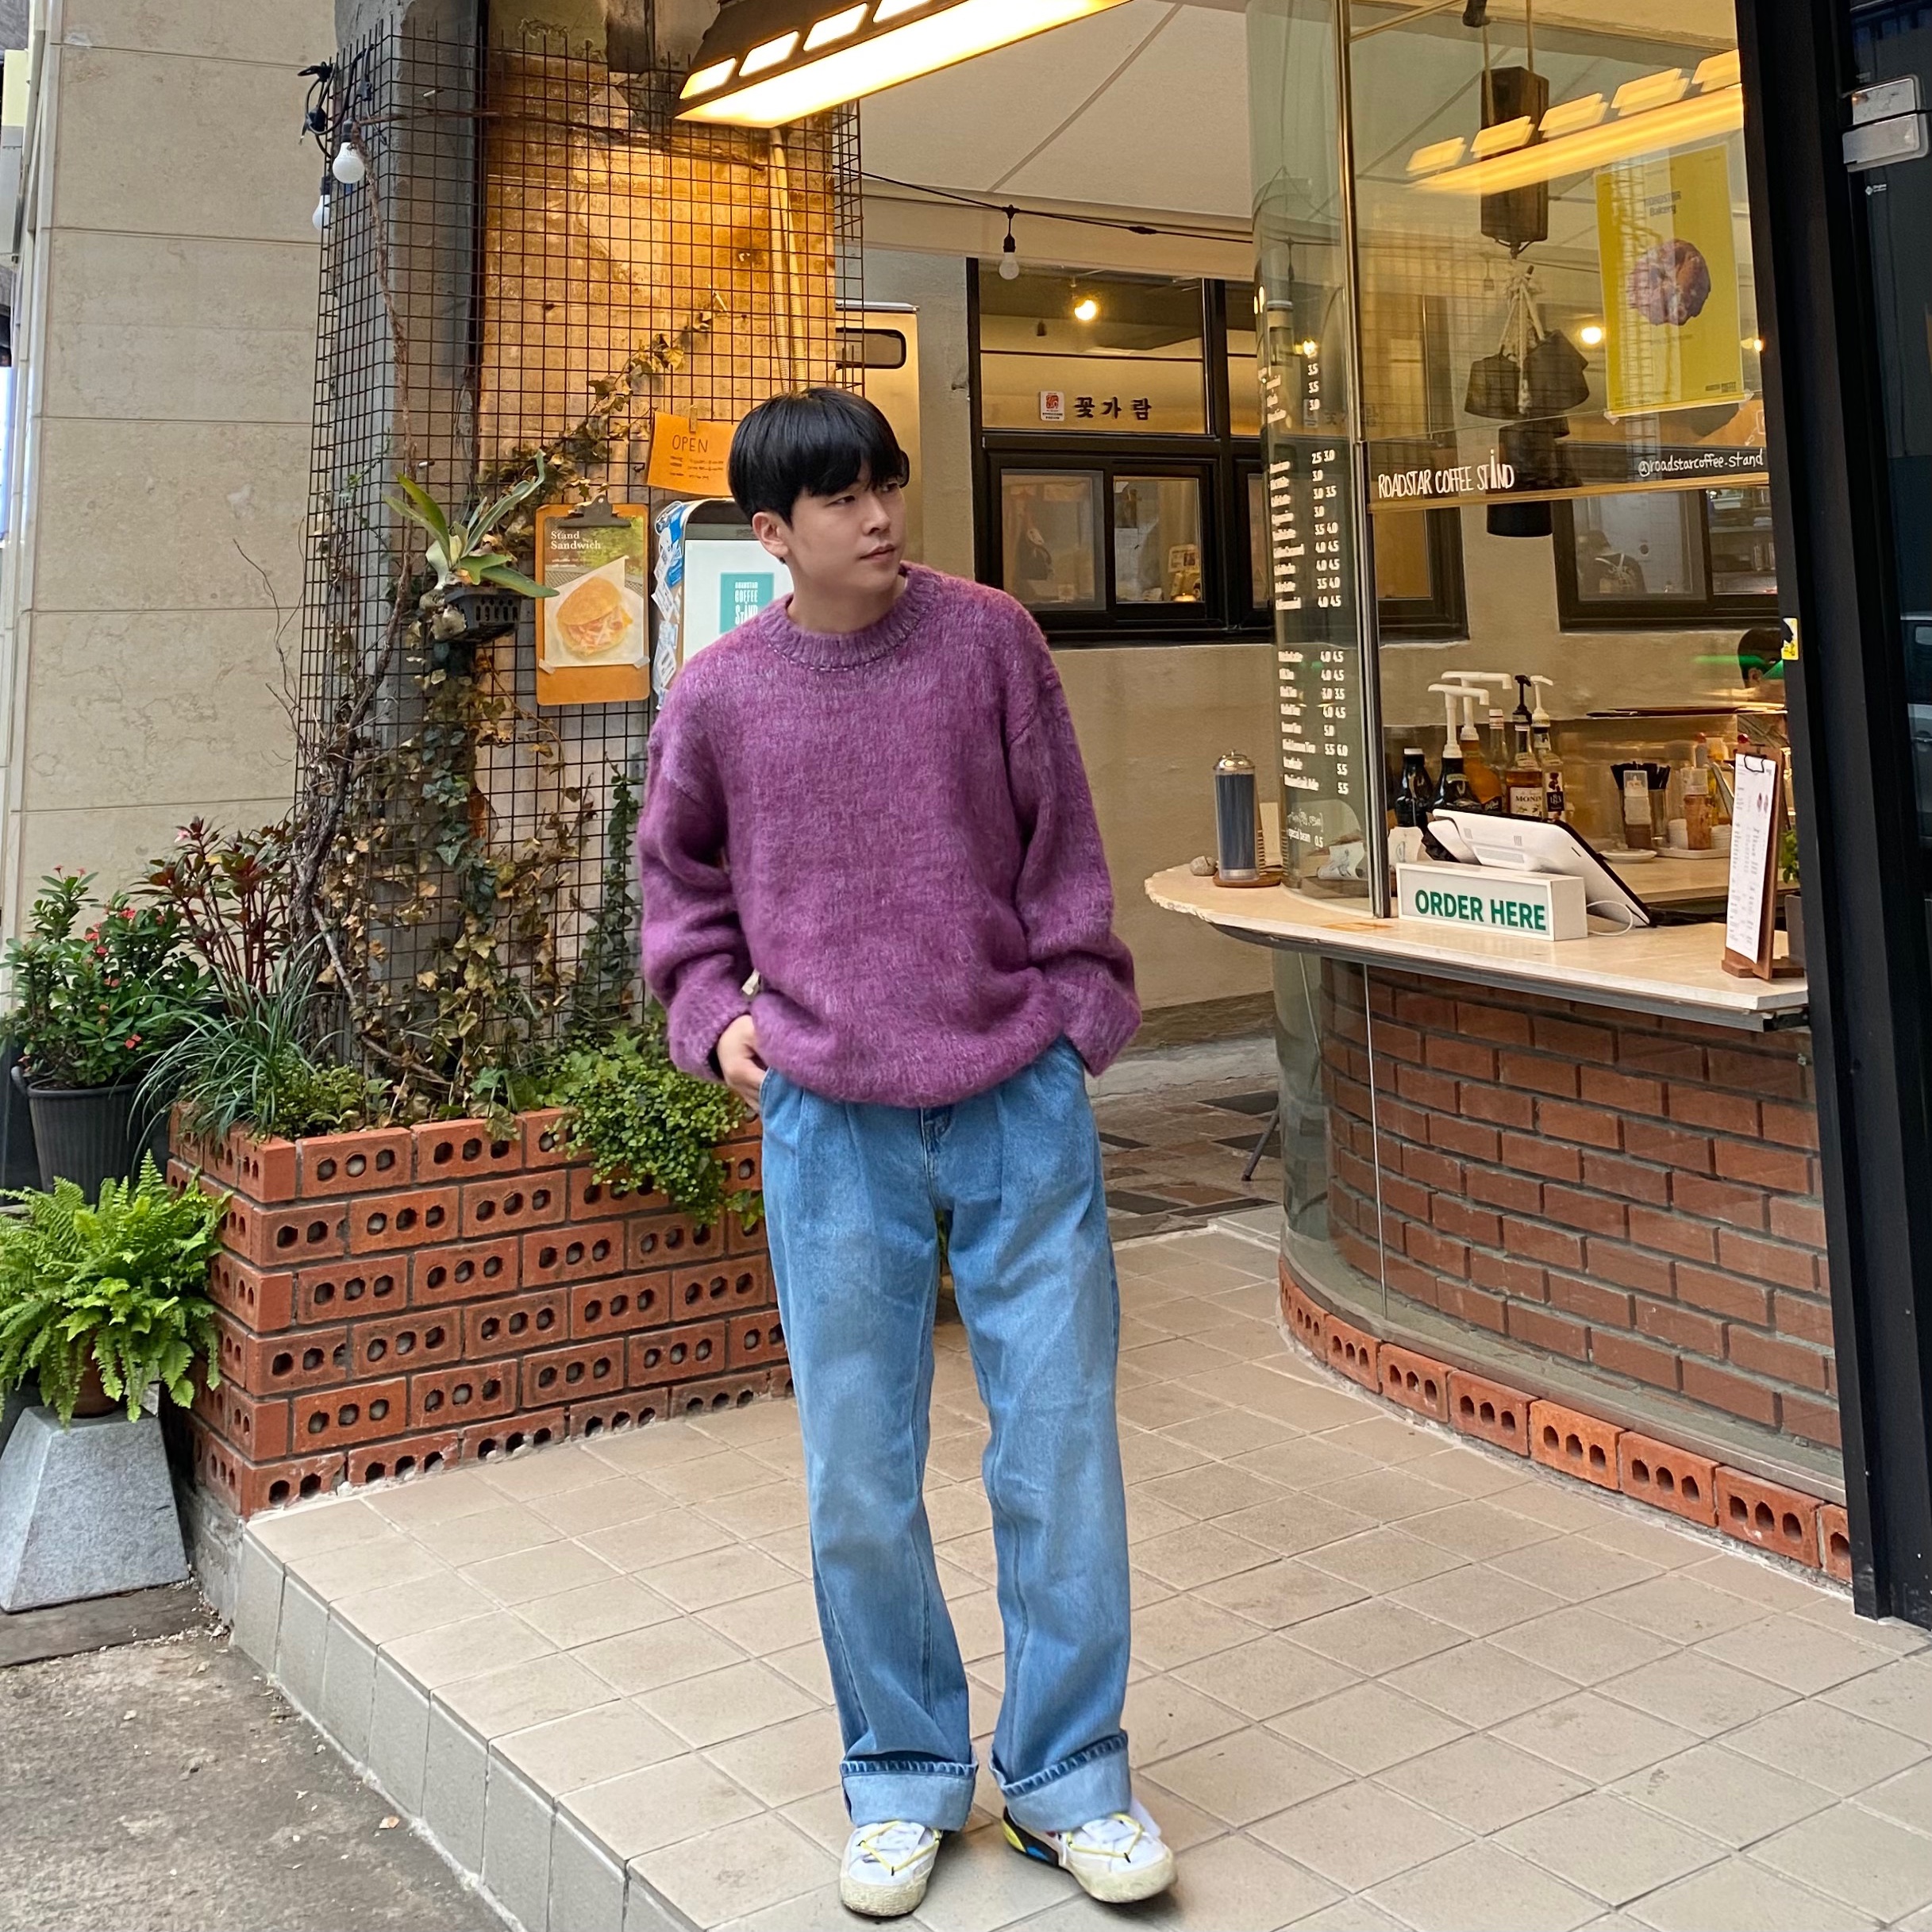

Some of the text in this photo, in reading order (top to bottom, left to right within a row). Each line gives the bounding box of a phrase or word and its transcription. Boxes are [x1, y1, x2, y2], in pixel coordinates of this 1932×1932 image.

[672, 434, 709, 453] OPEN
[1378, 469, 1433, 498] ROADSTAR
[1434, 466, 1474, 494] COFFEE
[551, 530, 580, 541] Stand
[551, 541, 602, 550] Sandwich
[735, 590, 758, 603] COFFEE
[1415, 889, 1546, 930] ORDER HERE
